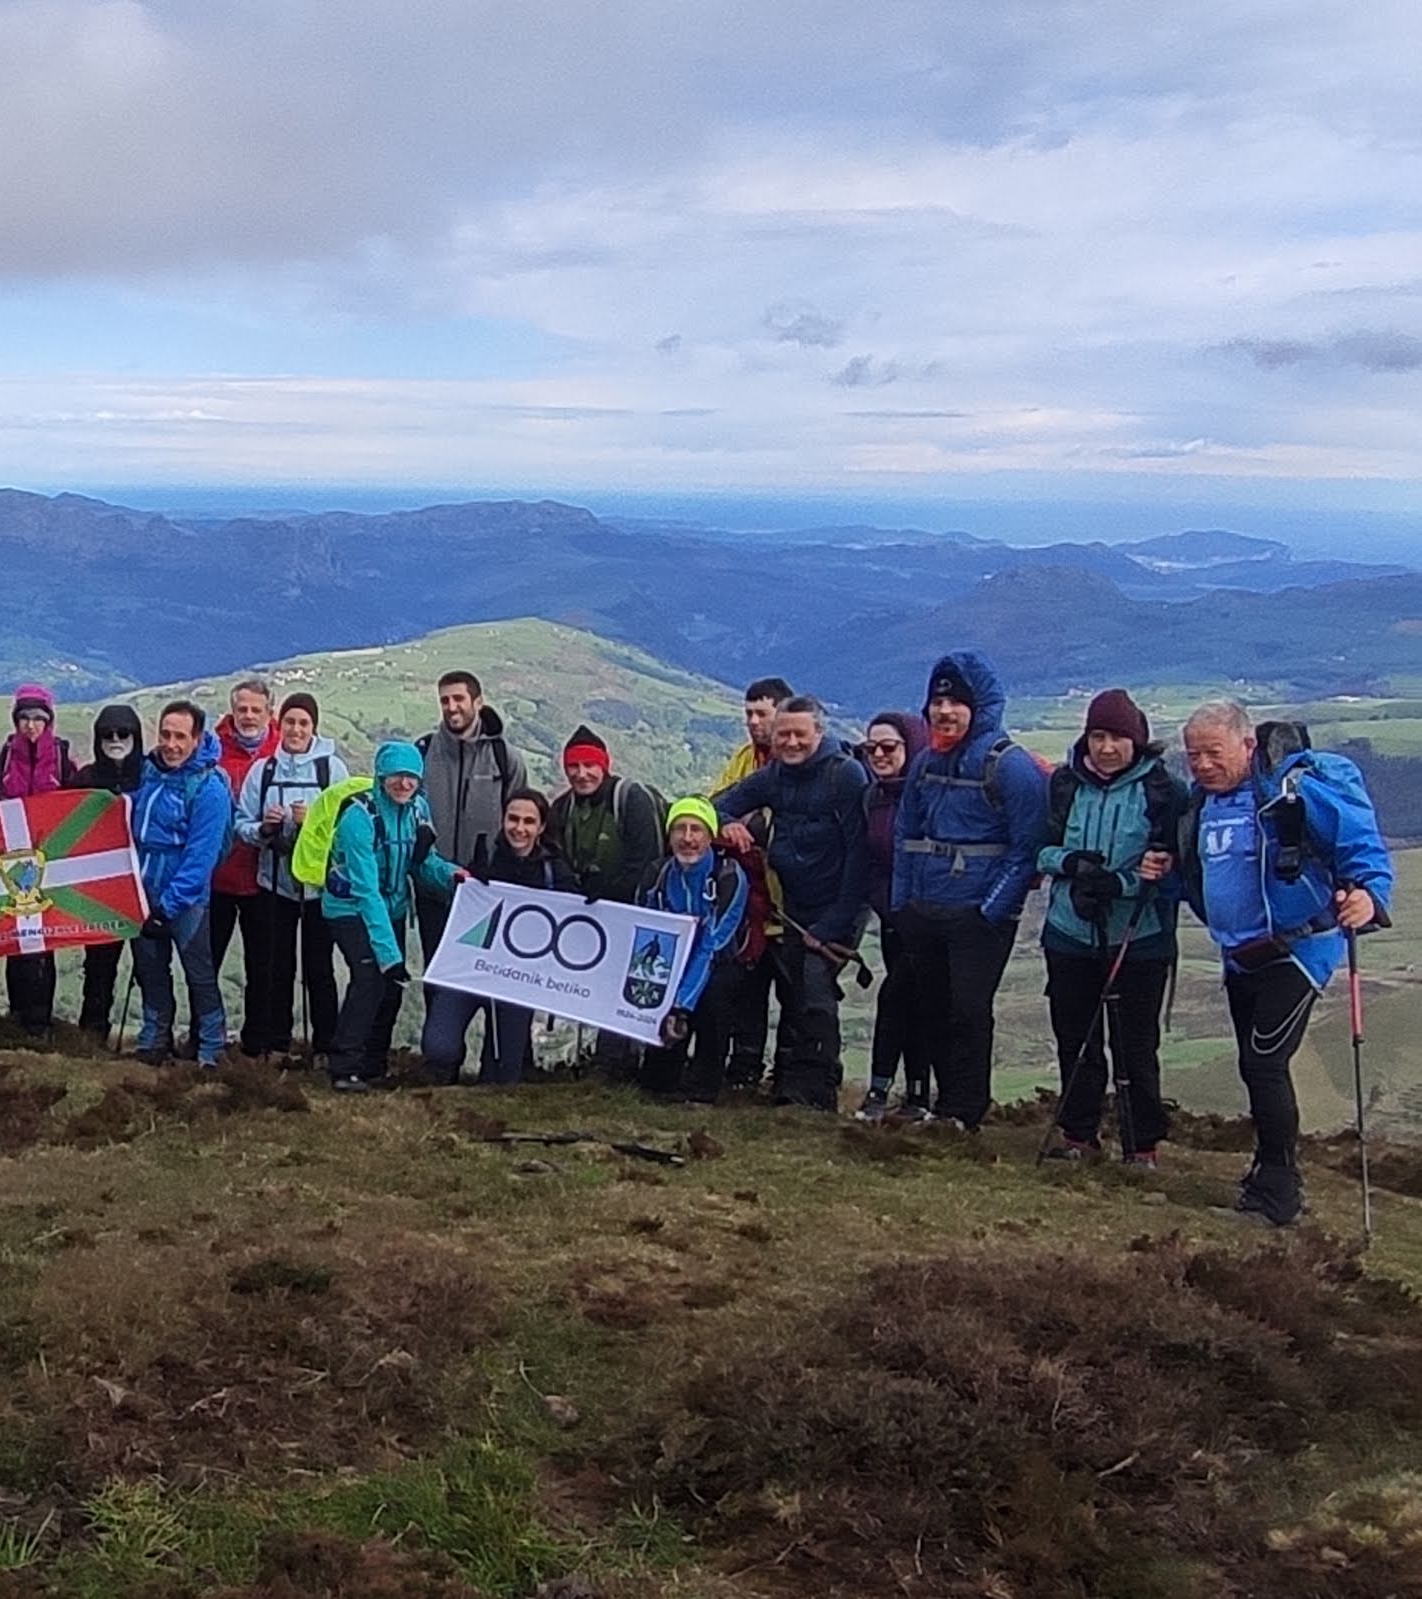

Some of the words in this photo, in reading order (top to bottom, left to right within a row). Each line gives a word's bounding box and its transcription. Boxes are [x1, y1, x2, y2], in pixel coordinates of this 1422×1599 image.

[457, 899, 607, 971] 100
[474, 959, 543, 986] Betidanik
[546, 976, 590, 998] betiko
